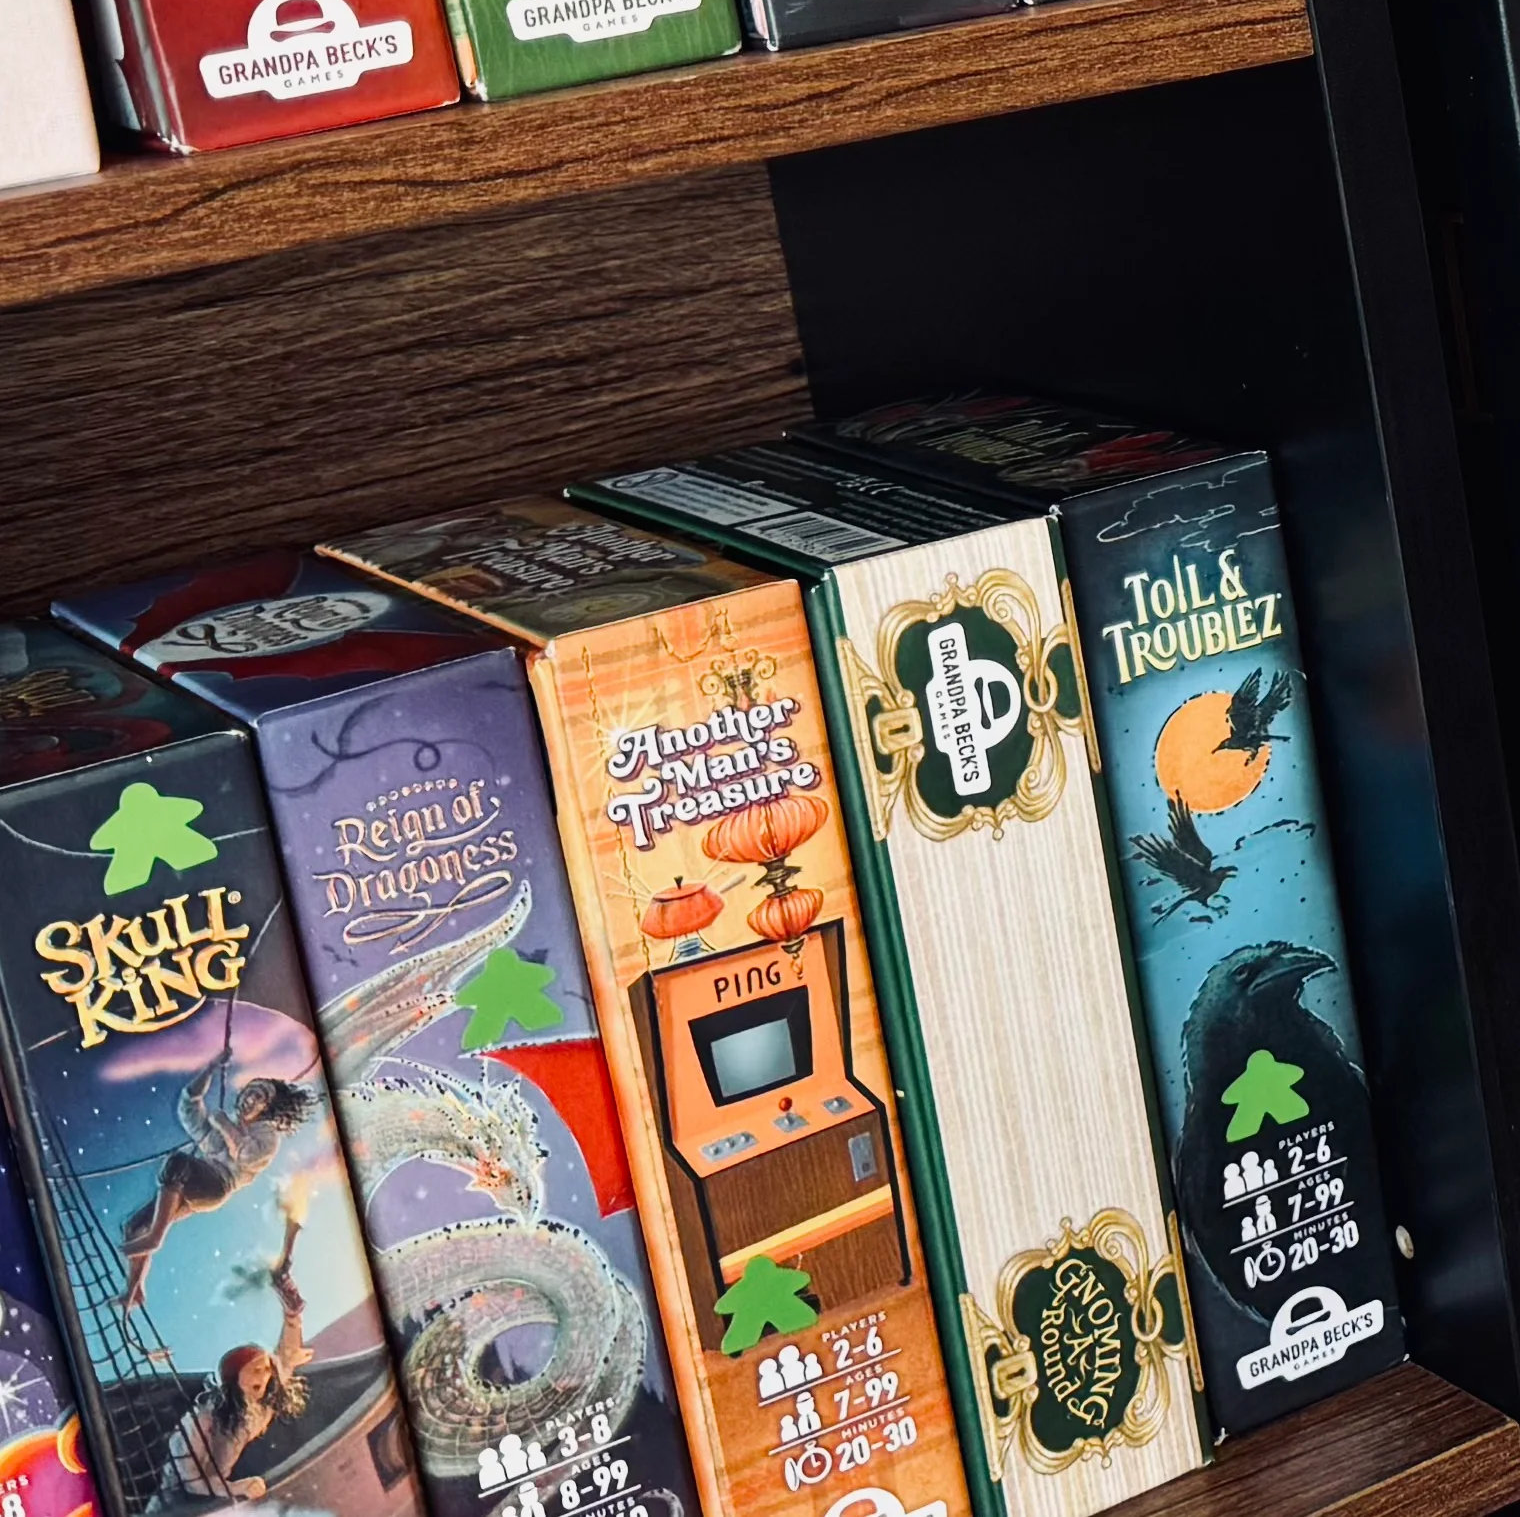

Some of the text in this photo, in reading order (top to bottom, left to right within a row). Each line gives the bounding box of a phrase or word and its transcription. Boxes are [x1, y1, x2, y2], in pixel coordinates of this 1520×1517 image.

[218, 34, 398, 85] GRANDPA BECK'S
[283, 70, 344, 88] GAMES
[939, 638, 979, 782] GRANDPA BECK'S
[609, 698, 798, 780] Another
[663, 733, 796, 794] Man's
[607, 761, 821, 850] Treasure
[313, 826, 518, 924] Dragoness
[35, 886, 250, 996] SKULL
[65, 939, 246, 1048] KING
[714, 962, 782, 1003] PING
[1279, 1121, 1335, 1149] PLAYERS
[1288, 1135, 1331, 1175] 2-6
[1288, 1178, 1344, 1222] 7-99
[1298, 1171, 1330, 1190] AGES
[1289, 1220, 1359, 1271] 20-30
[1293, 1211, 1349, 1241] MINUTES
[822, 1311, 887, 1343] PLAYERS
[832, 1327, 883, 1367] 2-6
[1250, 1313, 1373, 1377] GRANDPA BECK'S
[845, 1364, 883, 1386] AGES
[1294, 1348, 1336, 1370] GAMES
[834, 1372, 899, 1420] 7-99
[558, 1414, 612, 1457] 3-8
[837, 1418, 917, 1472] 20-30
[841, 1408, 905, 1439] MINUTES
[560, 1460, 628, 1509] 8-99
